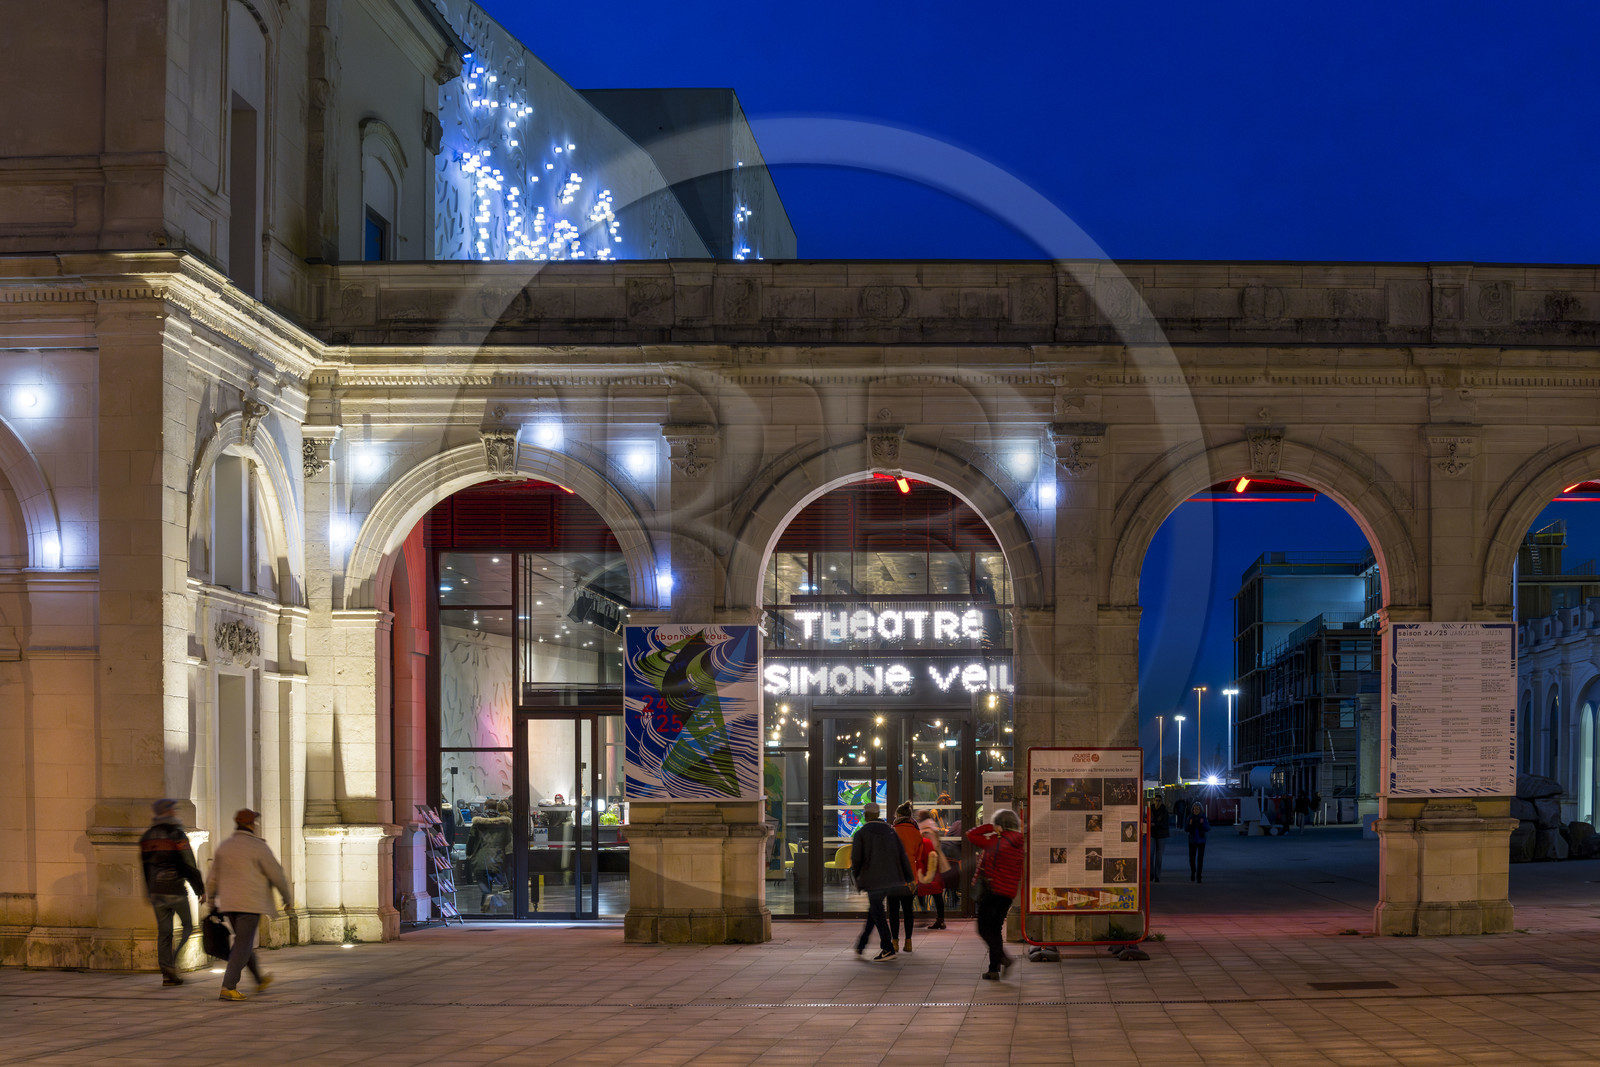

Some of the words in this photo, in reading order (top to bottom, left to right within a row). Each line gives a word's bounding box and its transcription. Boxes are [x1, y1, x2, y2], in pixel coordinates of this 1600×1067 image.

[641, 694, 669, 713] 24
[656, 714, 684, 733] 25
[847, 816, 860, 825] 25
